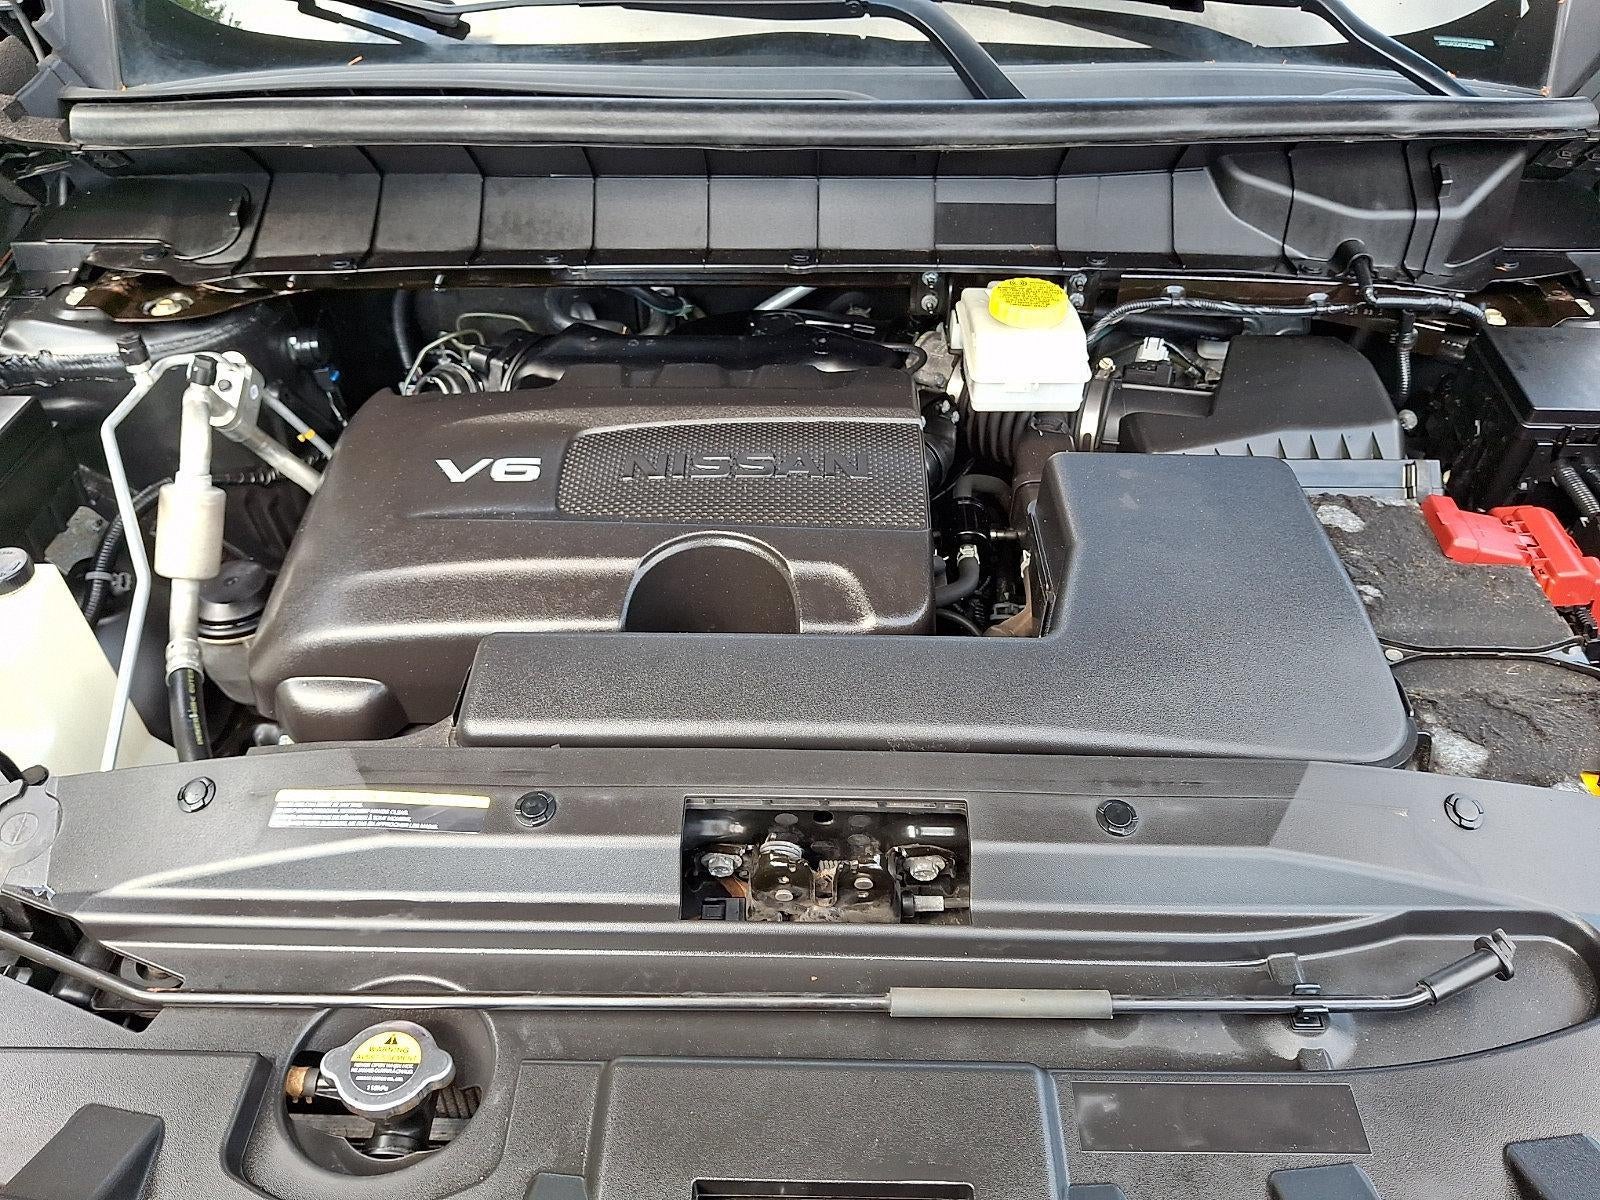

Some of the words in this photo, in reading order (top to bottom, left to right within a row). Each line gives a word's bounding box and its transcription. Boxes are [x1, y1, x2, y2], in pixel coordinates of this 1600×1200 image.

[435, 456, 541, 483] V6
[620, 450, 873, 481] NISSAN
[369, 1046, 410, 1054] WARNING
